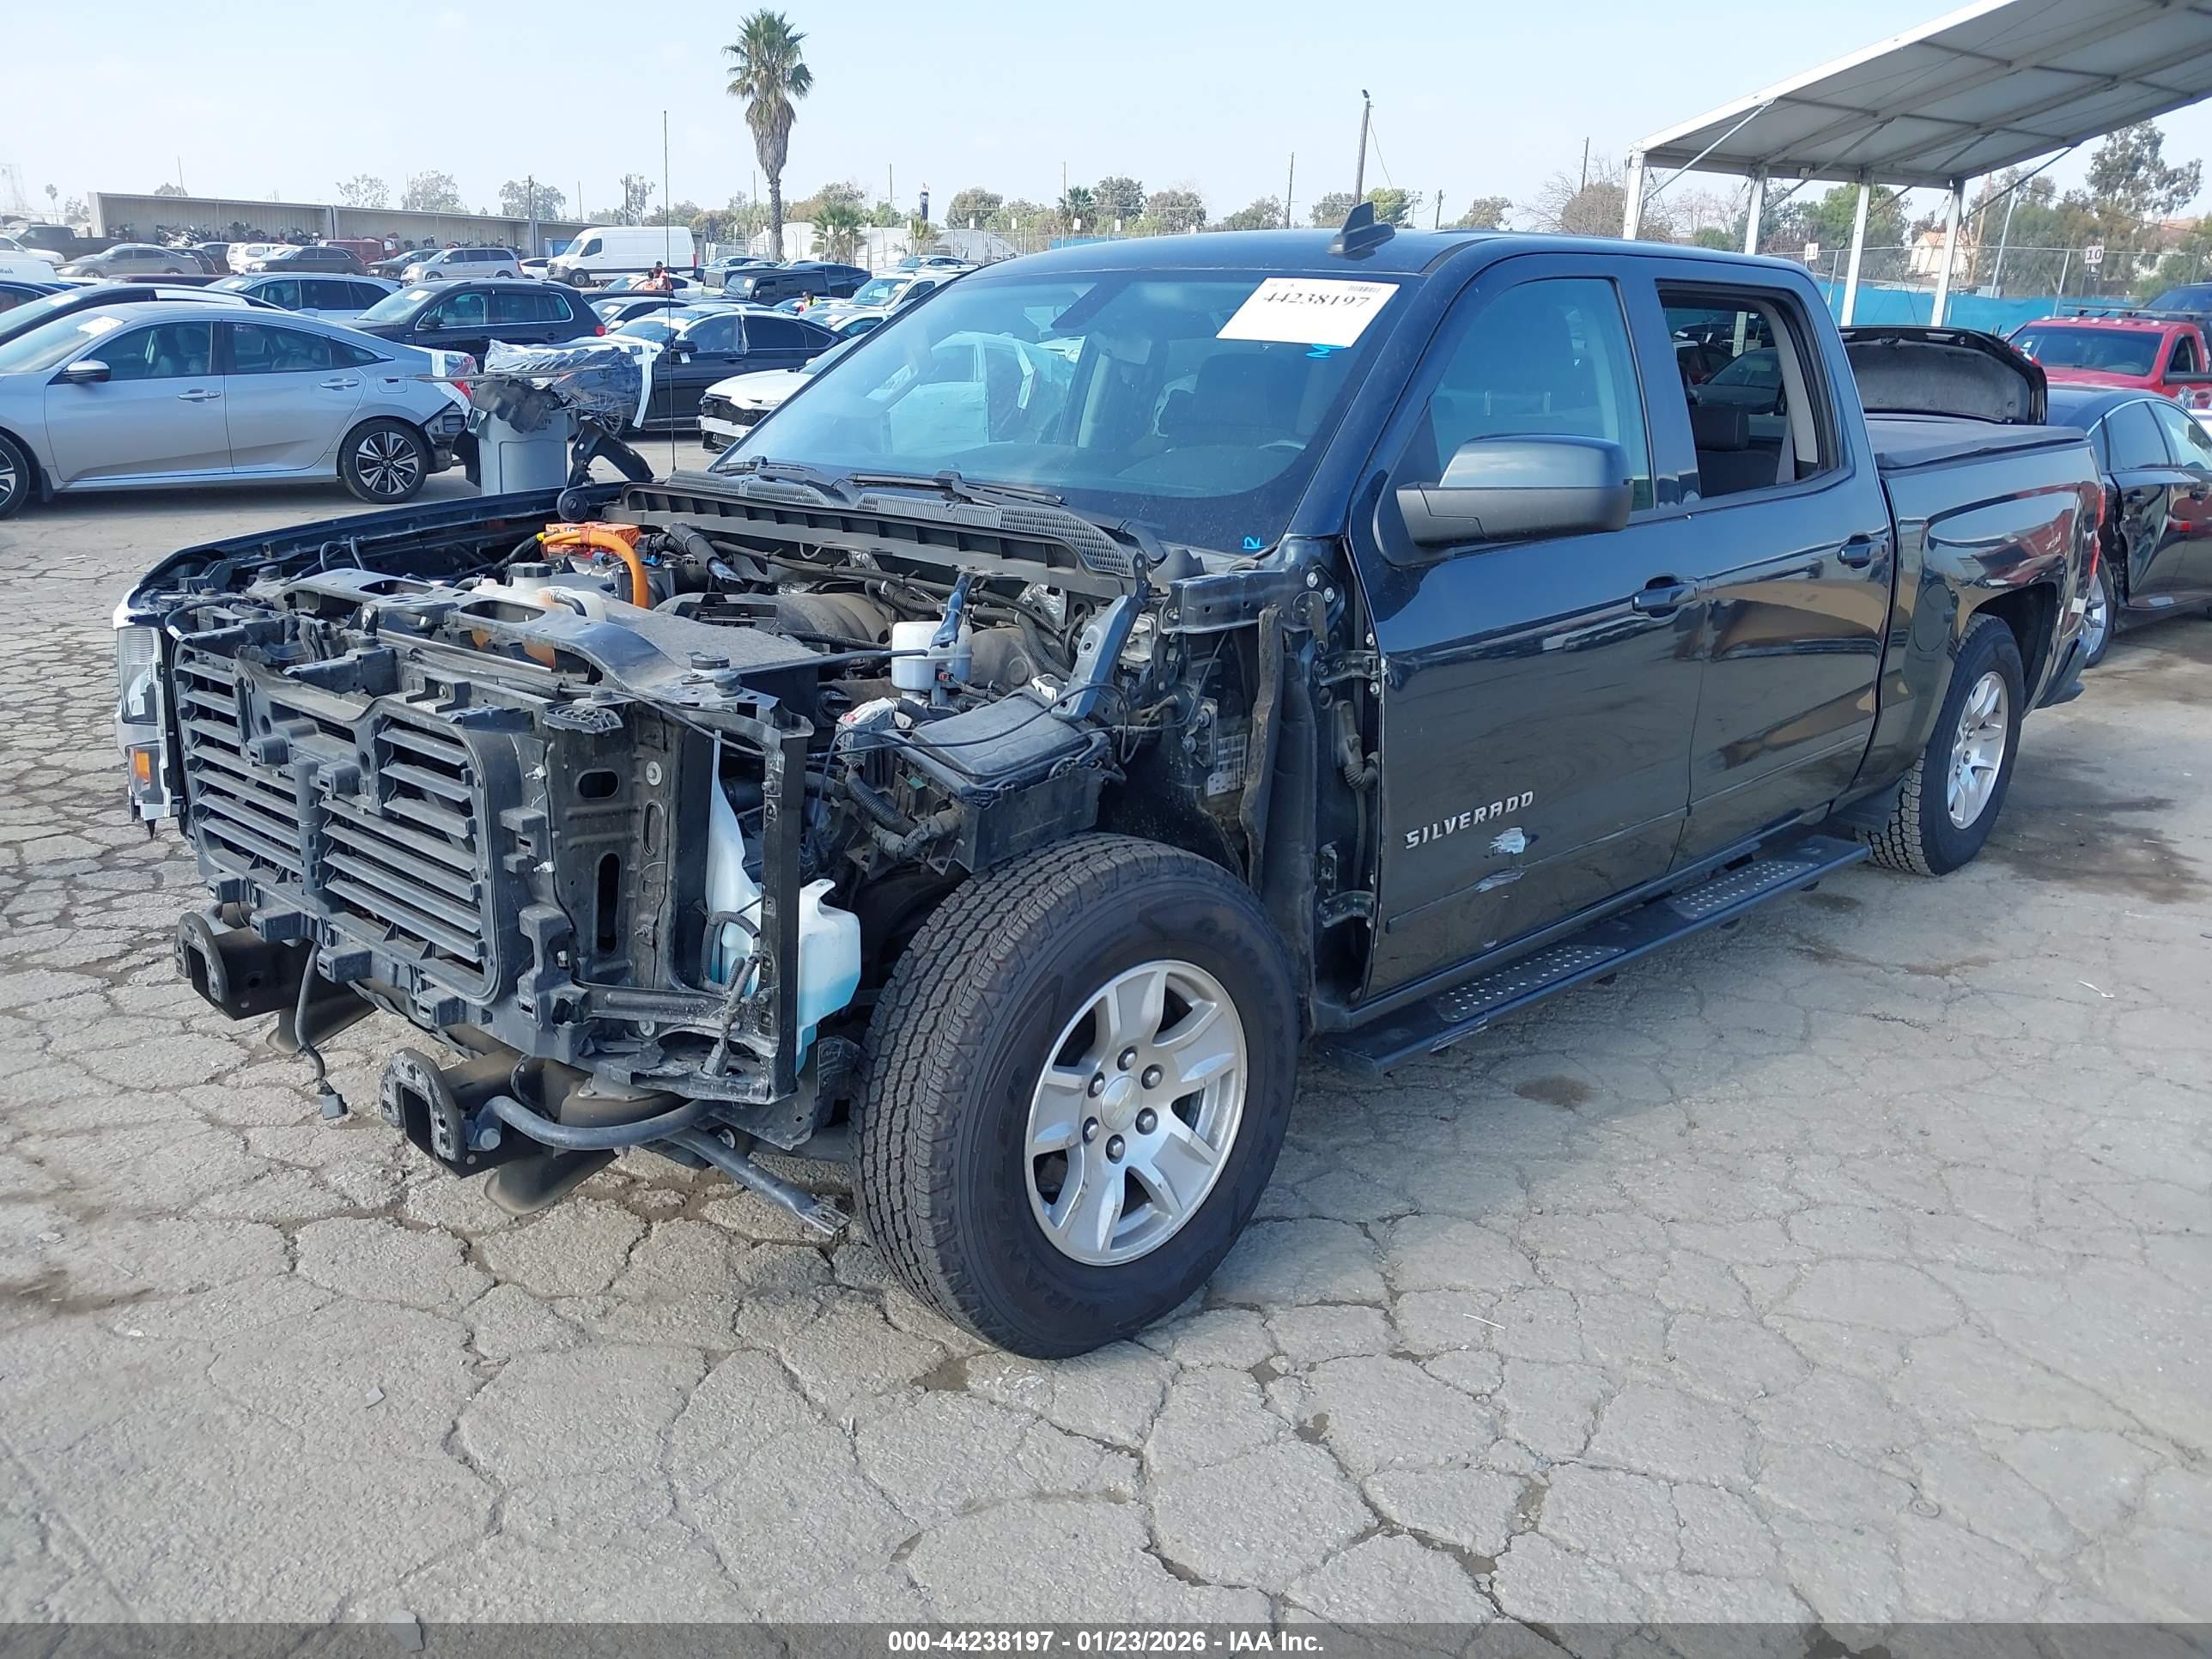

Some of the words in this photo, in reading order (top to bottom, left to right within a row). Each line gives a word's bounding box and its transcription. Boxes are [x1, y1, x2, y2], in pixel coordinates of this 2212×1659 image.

[2087, 249, 2102, 259] 10
[1264, 292, 1370, 307] 44238197
[1405, 791, 1534, 849] SILVERADO
